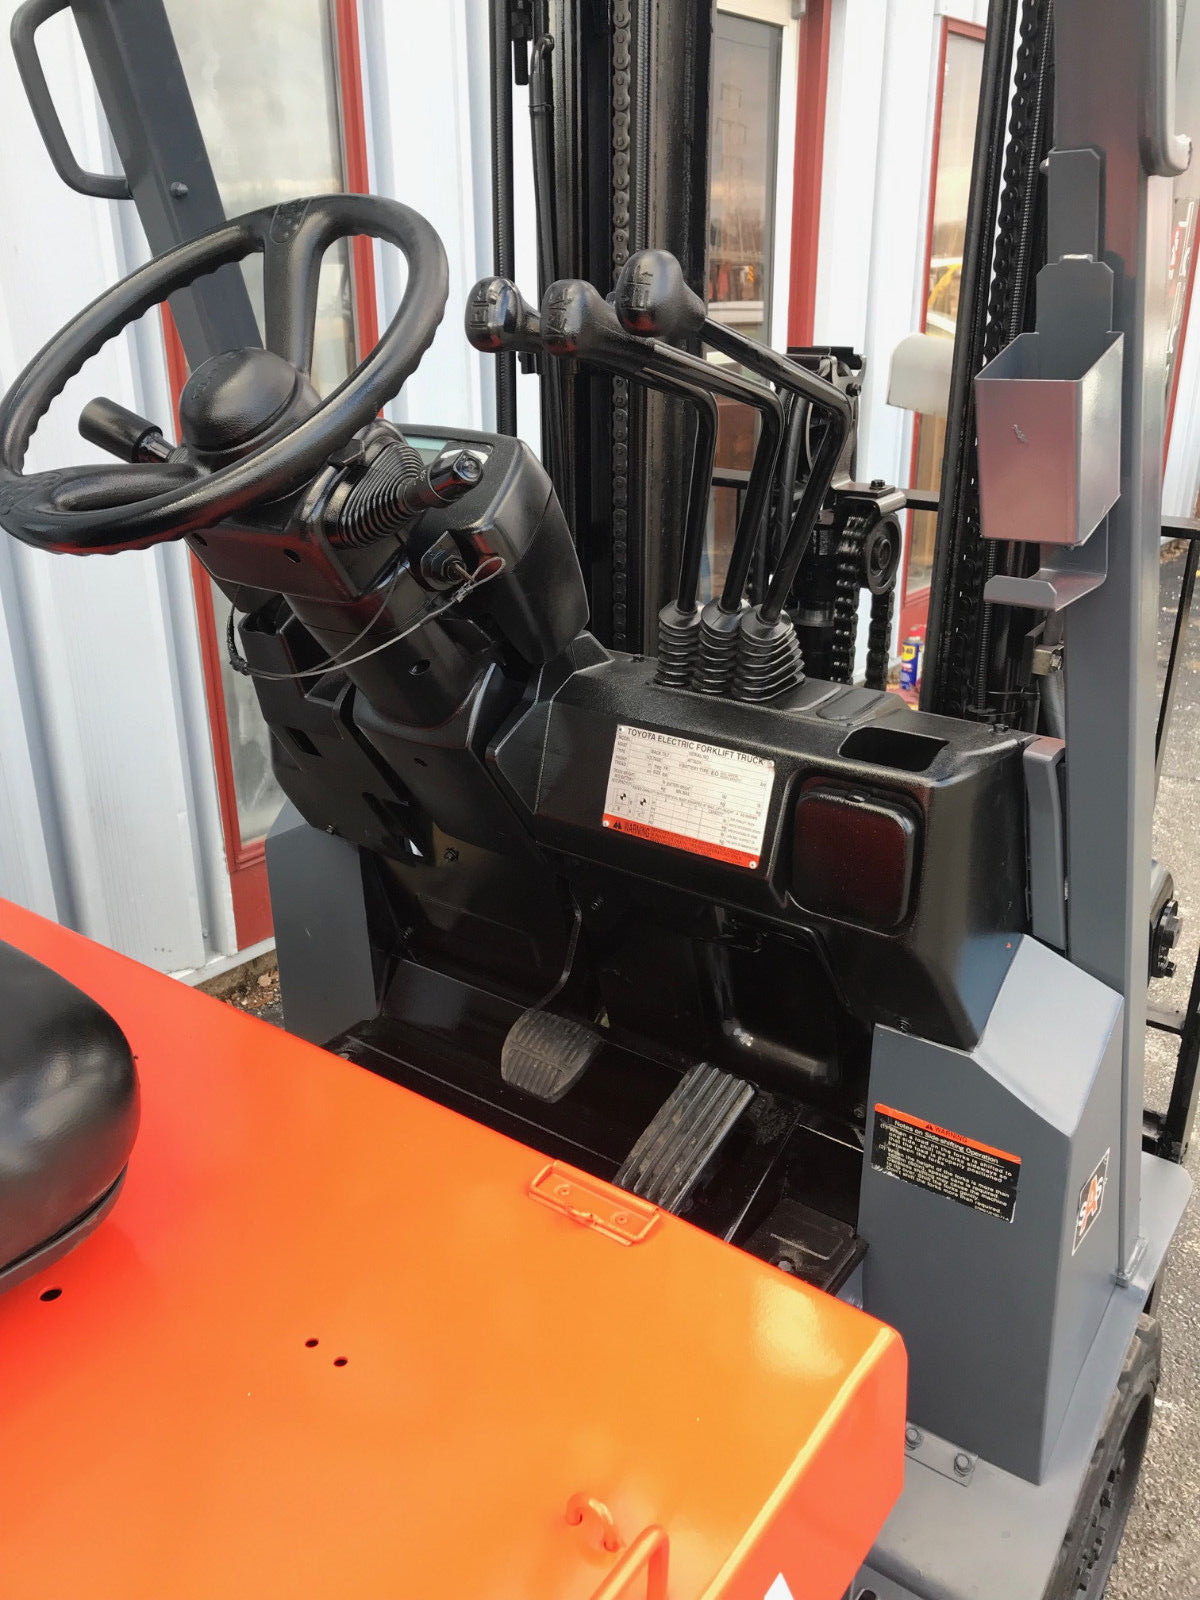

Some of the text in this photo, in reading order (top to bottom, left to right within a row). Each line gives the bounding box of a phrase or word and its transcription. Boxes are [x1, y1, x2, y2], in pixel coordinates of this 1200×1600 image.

[627, 727, 764, 765] TOYOTA ELECTRIC FORKLIFT TRUCK
[894, 1120, 913, 1131] Notes
[914, 1127, 923, 1135] on
[965, 1146, 999, 1165] Operation
[935, 1126, 968, 1143] WARNING
[953, 1151, 970, 1161] forks
[980, 1161, 1003, 1174] shifted
[966, 1161, 997, 1177] sideways
[967, 1166, 1002, 1184] positioned
